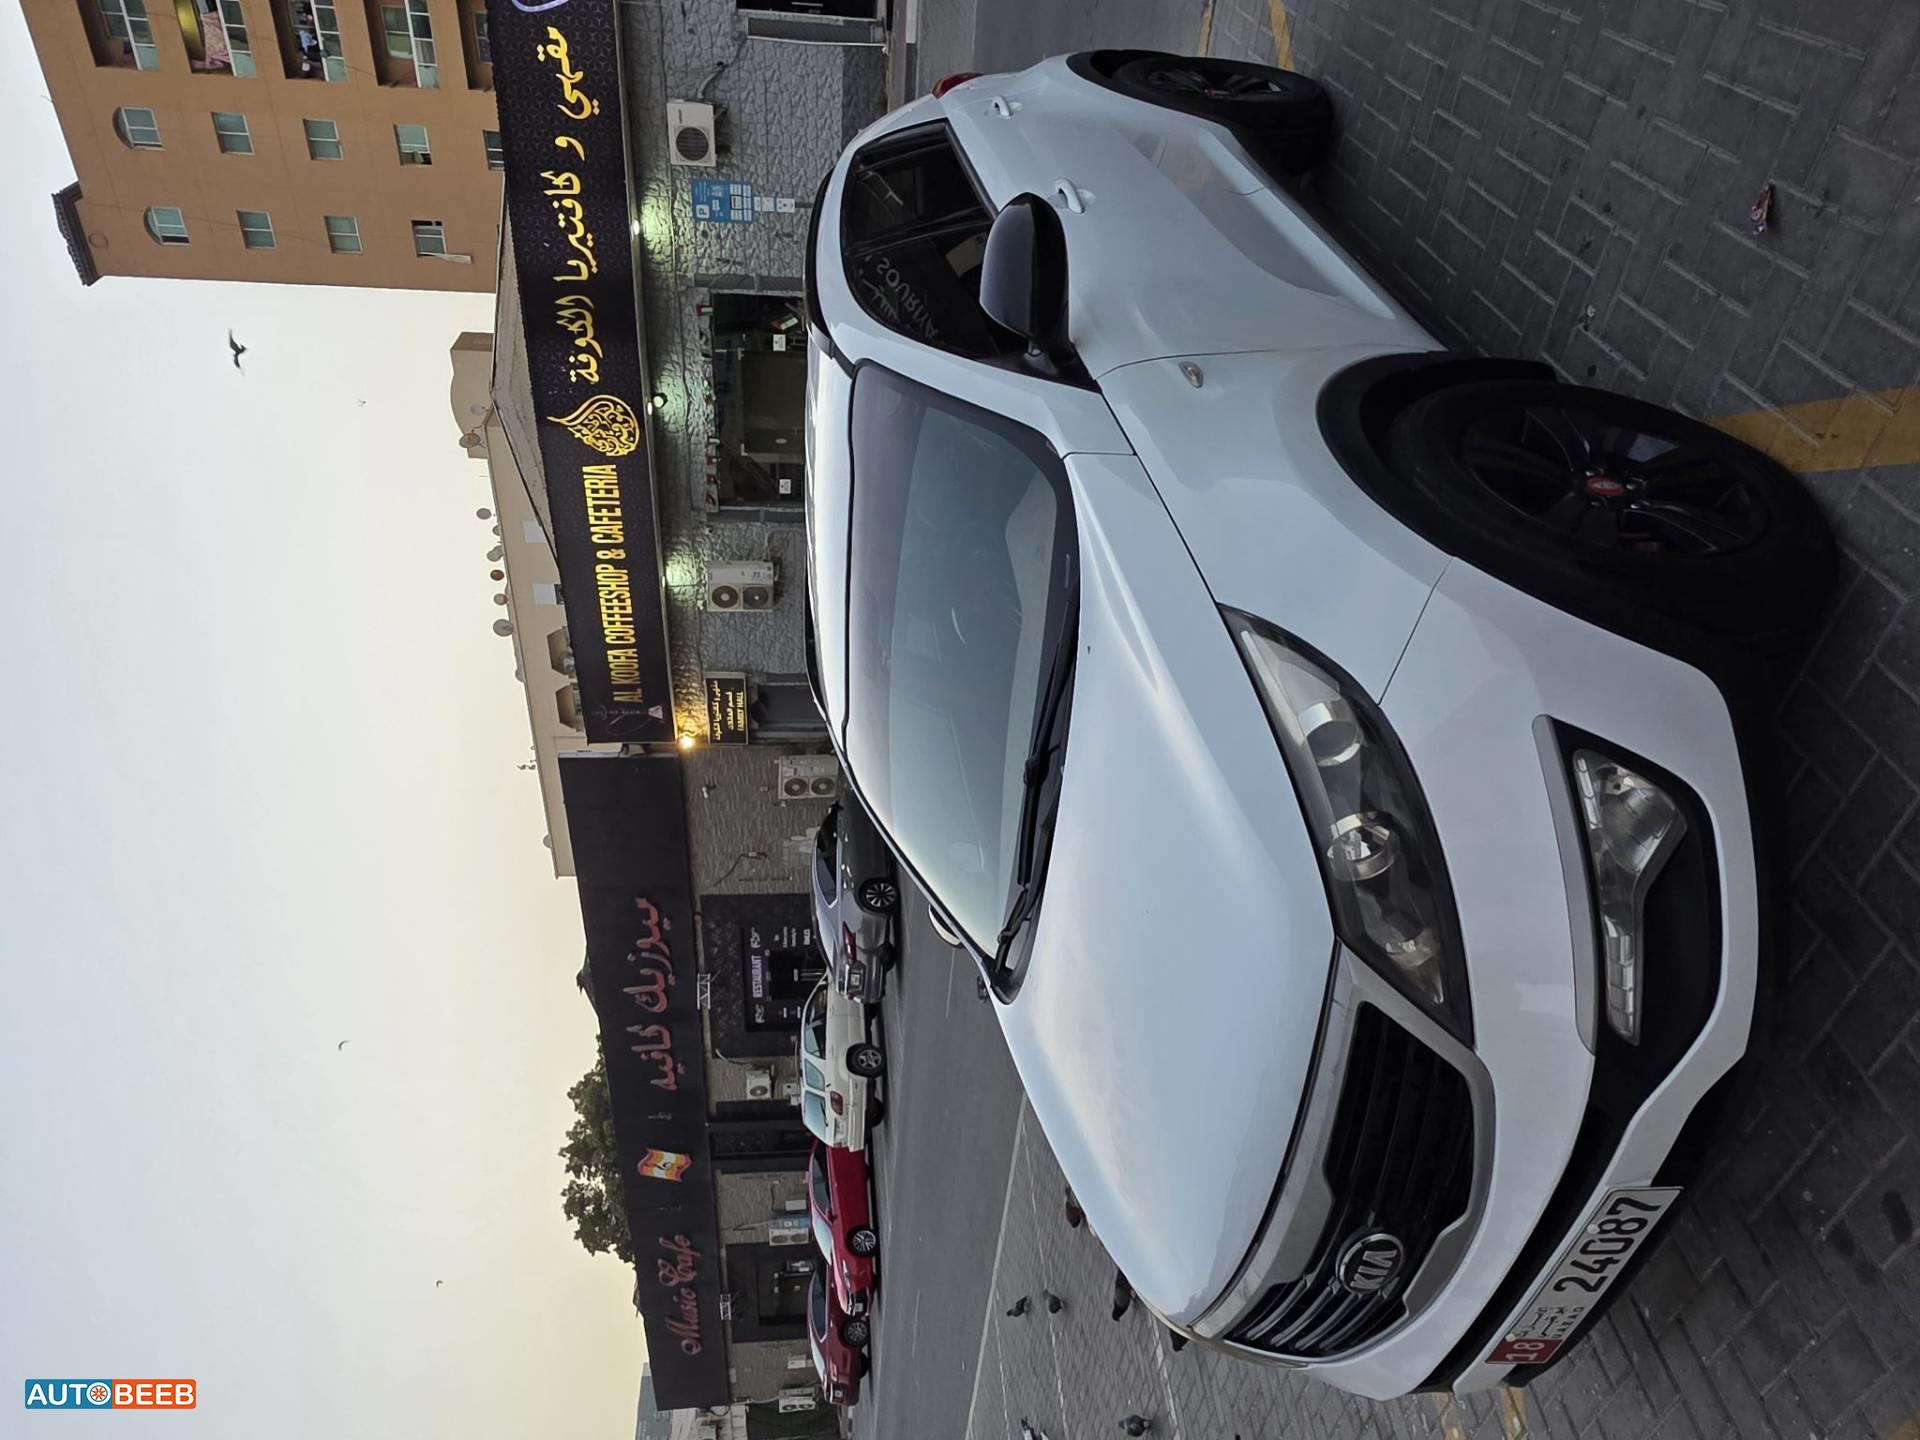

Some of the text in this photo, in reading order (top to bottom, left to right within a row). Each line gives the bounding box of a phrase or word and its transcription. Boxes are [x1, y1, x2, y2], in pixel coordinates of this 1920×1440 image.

[553, 135, 586, 161] و
[539, 170, 599, 282] كافتيريا
[554, 294, 604, 384] الكوفة
[582, 464, 643, 703] AL KOOFA COFFEESHOP & CAFETERIA
[622, 897, 685, 1090] ميوزيك كافيه
[751, 955, 763, 998] RESTAURANT
[656, 1234, 702, 1356] Music Cafe
[1349, 1249, 1398, 1290] KIA
[1505, 1196, 1662, 1361] 18 24087
